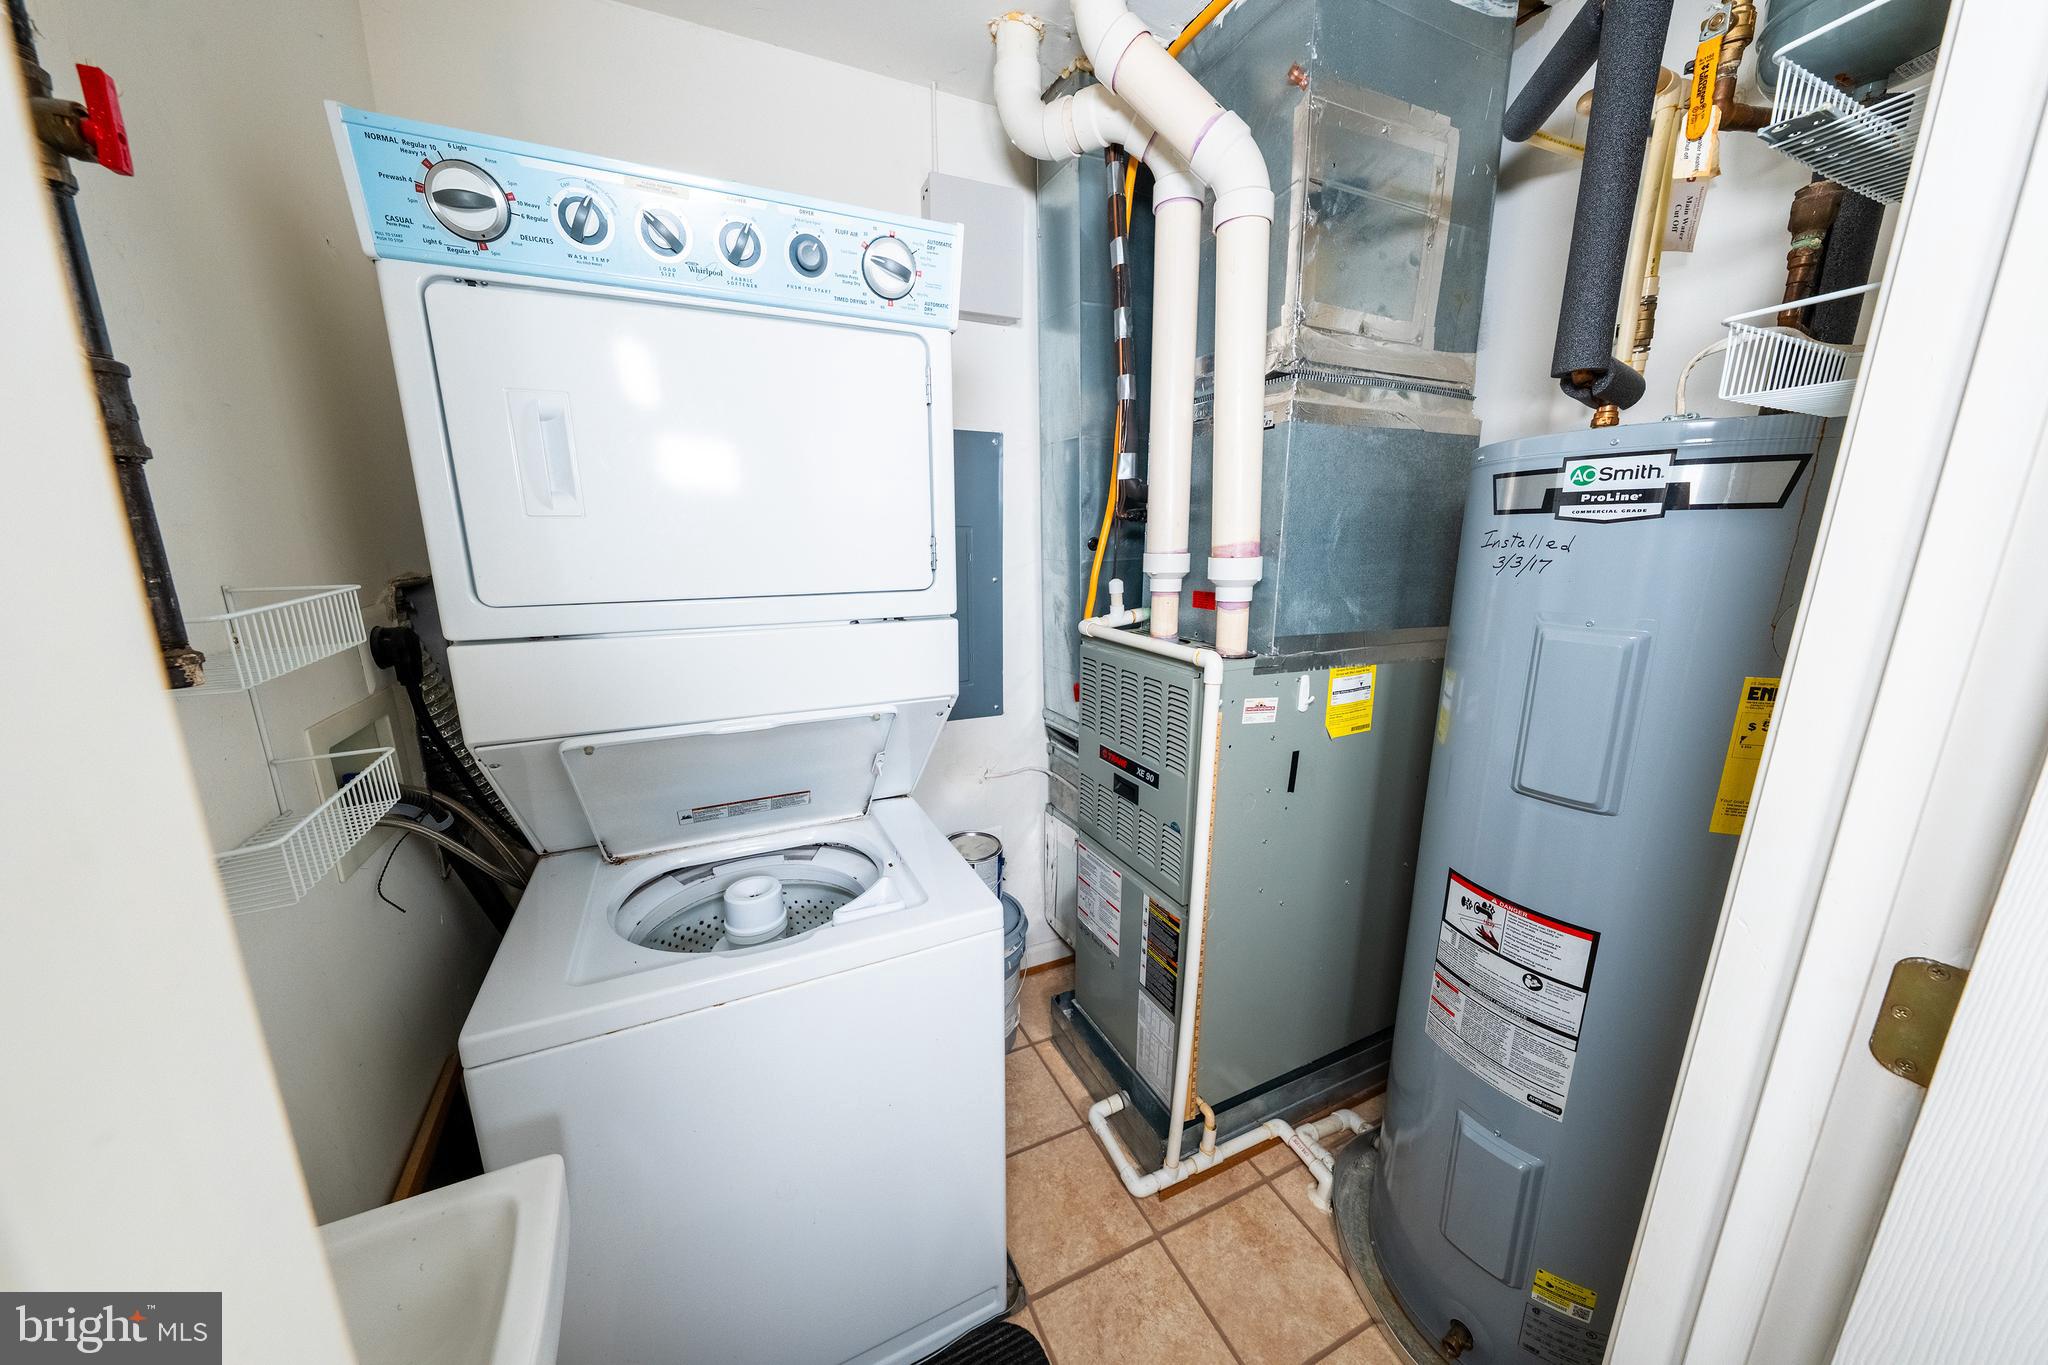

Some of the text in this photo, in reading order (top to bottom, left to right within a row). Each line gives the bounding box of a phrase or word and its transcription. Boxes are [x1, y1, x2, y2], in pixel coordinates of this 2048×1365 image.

[364, 131, 437, 151] NORMAL Regular 10
[400, 147, 419, 157] Heavy
[452, 143, 468, 152] Light
[378, 171, 407, 182] Prewash
[524, 202, 541, 210] Heavy
[384, 214, 414, 225] CASUAL
[526, 214, 549, 223] Regular
[1672, 204, 1682, 233] Cut Off
[1679, 195, 1694, 240] Main Water
[422, 237, 438, 246] Light
[519, 234, 554, 245] DELICATES
[927, 239, 952, 249] AUTOMATIC
[446, 246, 471, 255] Regular
[567, 253, 588, 261] WASH
[687, 265, 723, 277] Whirlpool
[726, 280, 758, 289] SOFTENER
[730, 276, 753, 284] FABRIC
[834, 295, 849, 303] TIMED
[924, 301, 949, 310] AUTOMATIC
[1580, 492, 1641, 503] ProLine
[1480, 529, 1576, 553] Installed
[1492, 552, 1553, 578] 3/3/17
[1136, 767, 1155, 783] XE 90
[1499, 901, 1528, 918] DANGER
